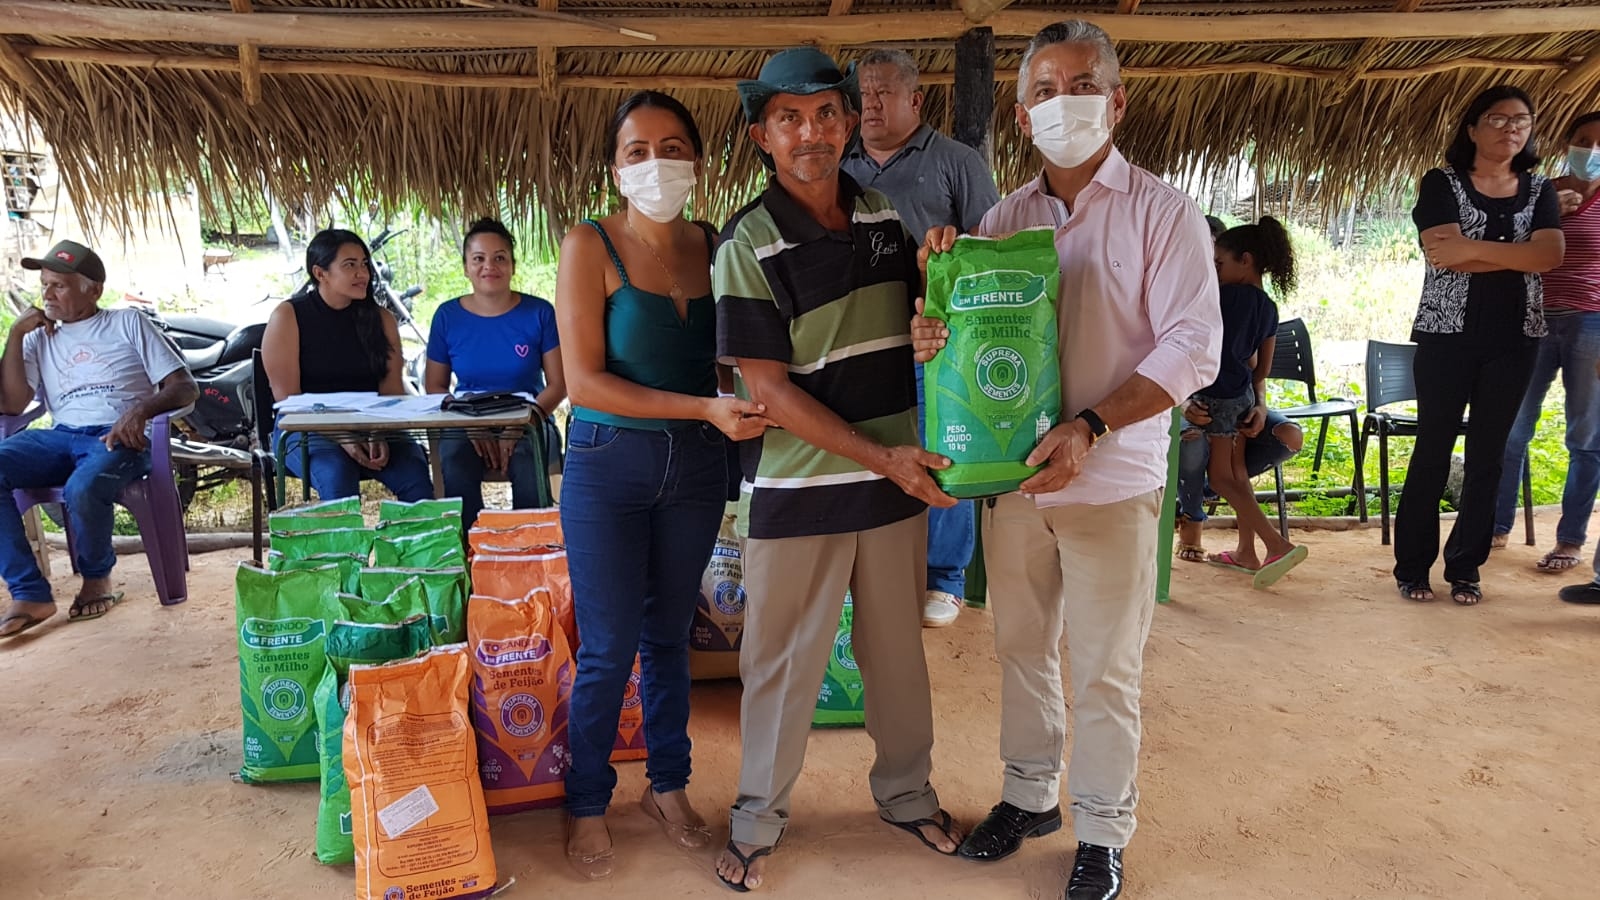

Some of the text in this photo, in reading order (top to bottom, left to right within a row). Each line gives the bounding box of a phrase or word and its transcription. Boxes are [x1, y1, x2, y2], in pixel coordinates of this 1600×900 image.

[973, 291, 1024, 305] FRENTE
[965, 314, 1032, 326] Sementes
[970, 326, 1031, 339] de Milho
[981, 349, 1021, 367] SUPREMA
[983, 382, 1021, 398] SEMENTES
[946, 424, 967, 434] PESO
[948, 443, 967, 452] 10 kg
[713, 569, 725, 577] de
[260, 634, 303, 646] FRENTE
[252, 652, 310, 663] Sementes
[495, 649, 537, 664] FRENTE
[257, 661, 309, 673] de Milho
[489, 666, 542, 680] Sementes
[266, 680, 300, 695] SUPREMA
[493, 681, 507, 690] de
[503, 695, 538, 711] SUPREMA
[269, 705, 300, 719] SEMENTES
[506, 720, 539, 735] SEMENTES
[406, 877, 457, 893] Sementes
[409, 892, 421, 900] de
[423, 886, 455, 899] Feijão
